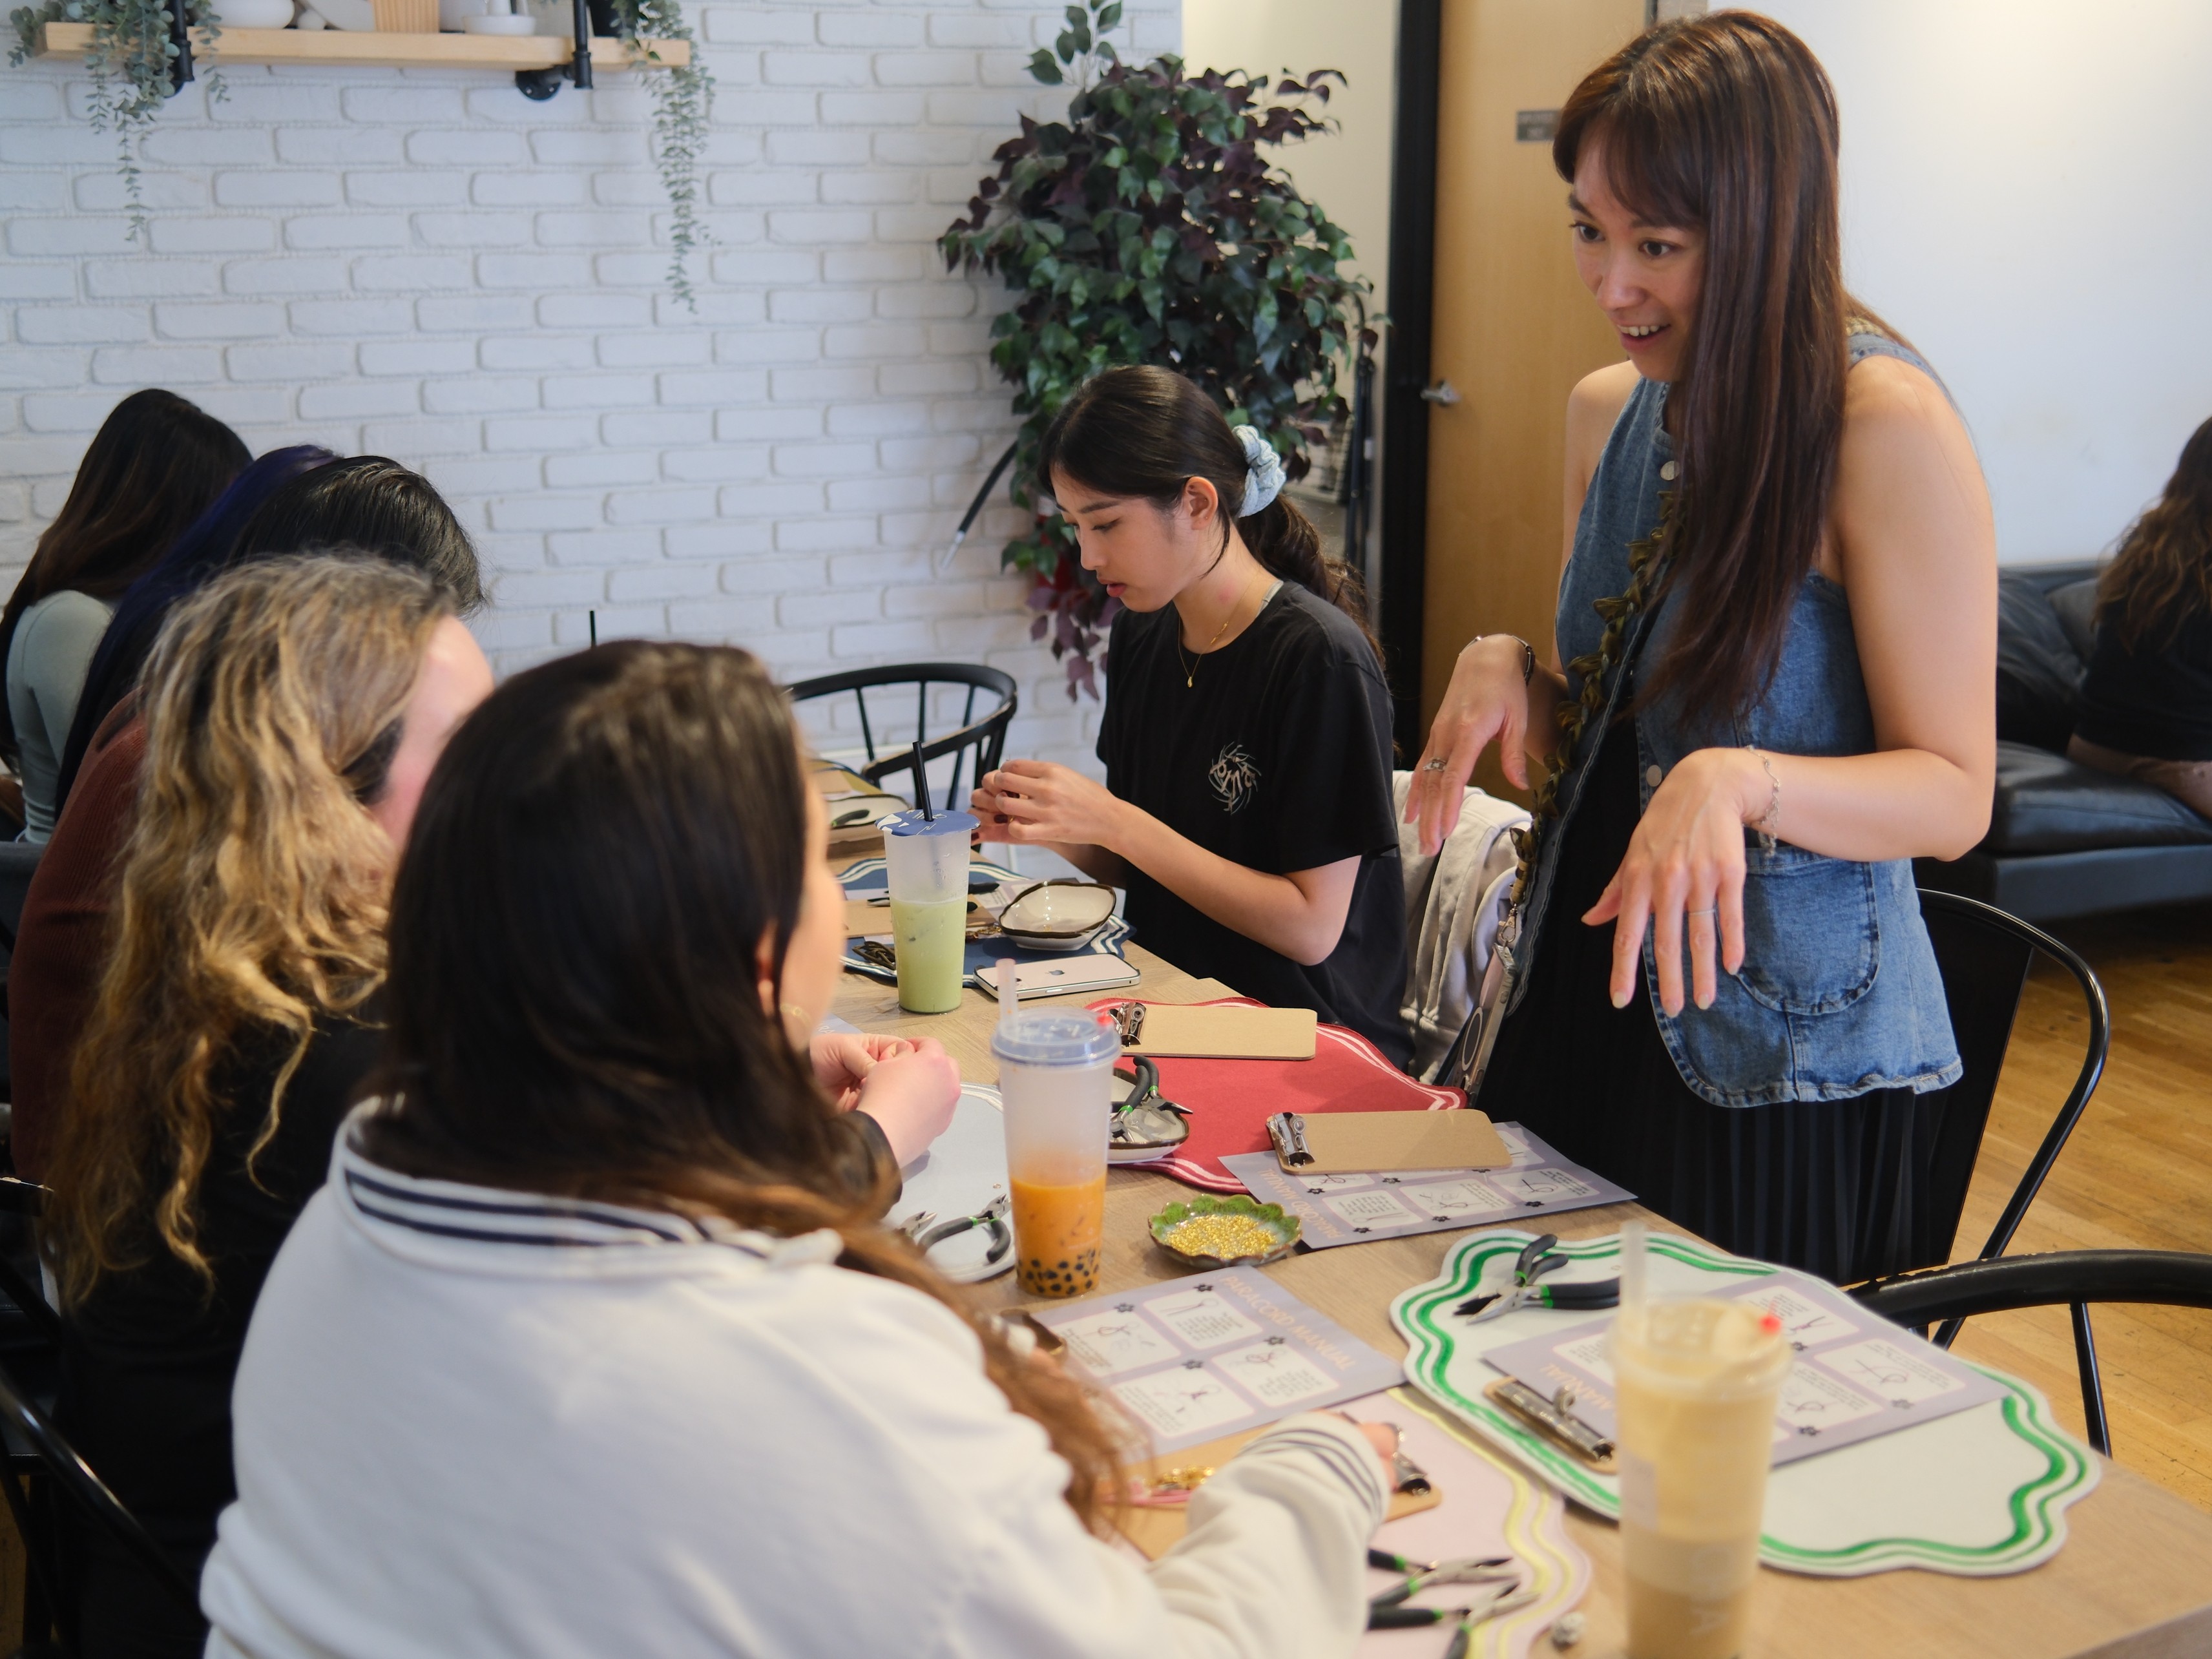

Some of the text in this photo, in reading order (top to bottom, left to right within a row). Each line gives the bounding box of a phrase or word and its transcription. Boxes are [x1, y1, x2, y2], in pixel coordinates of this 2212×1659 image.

[1257, 1169, 1302, 1200] MANUAL
[1291, 1201, 1345, 1238] PARACORD
[1219, 1276, 1295, 1325] PARACORD
[1289, 1325, 1356, 1371] MANUAL
